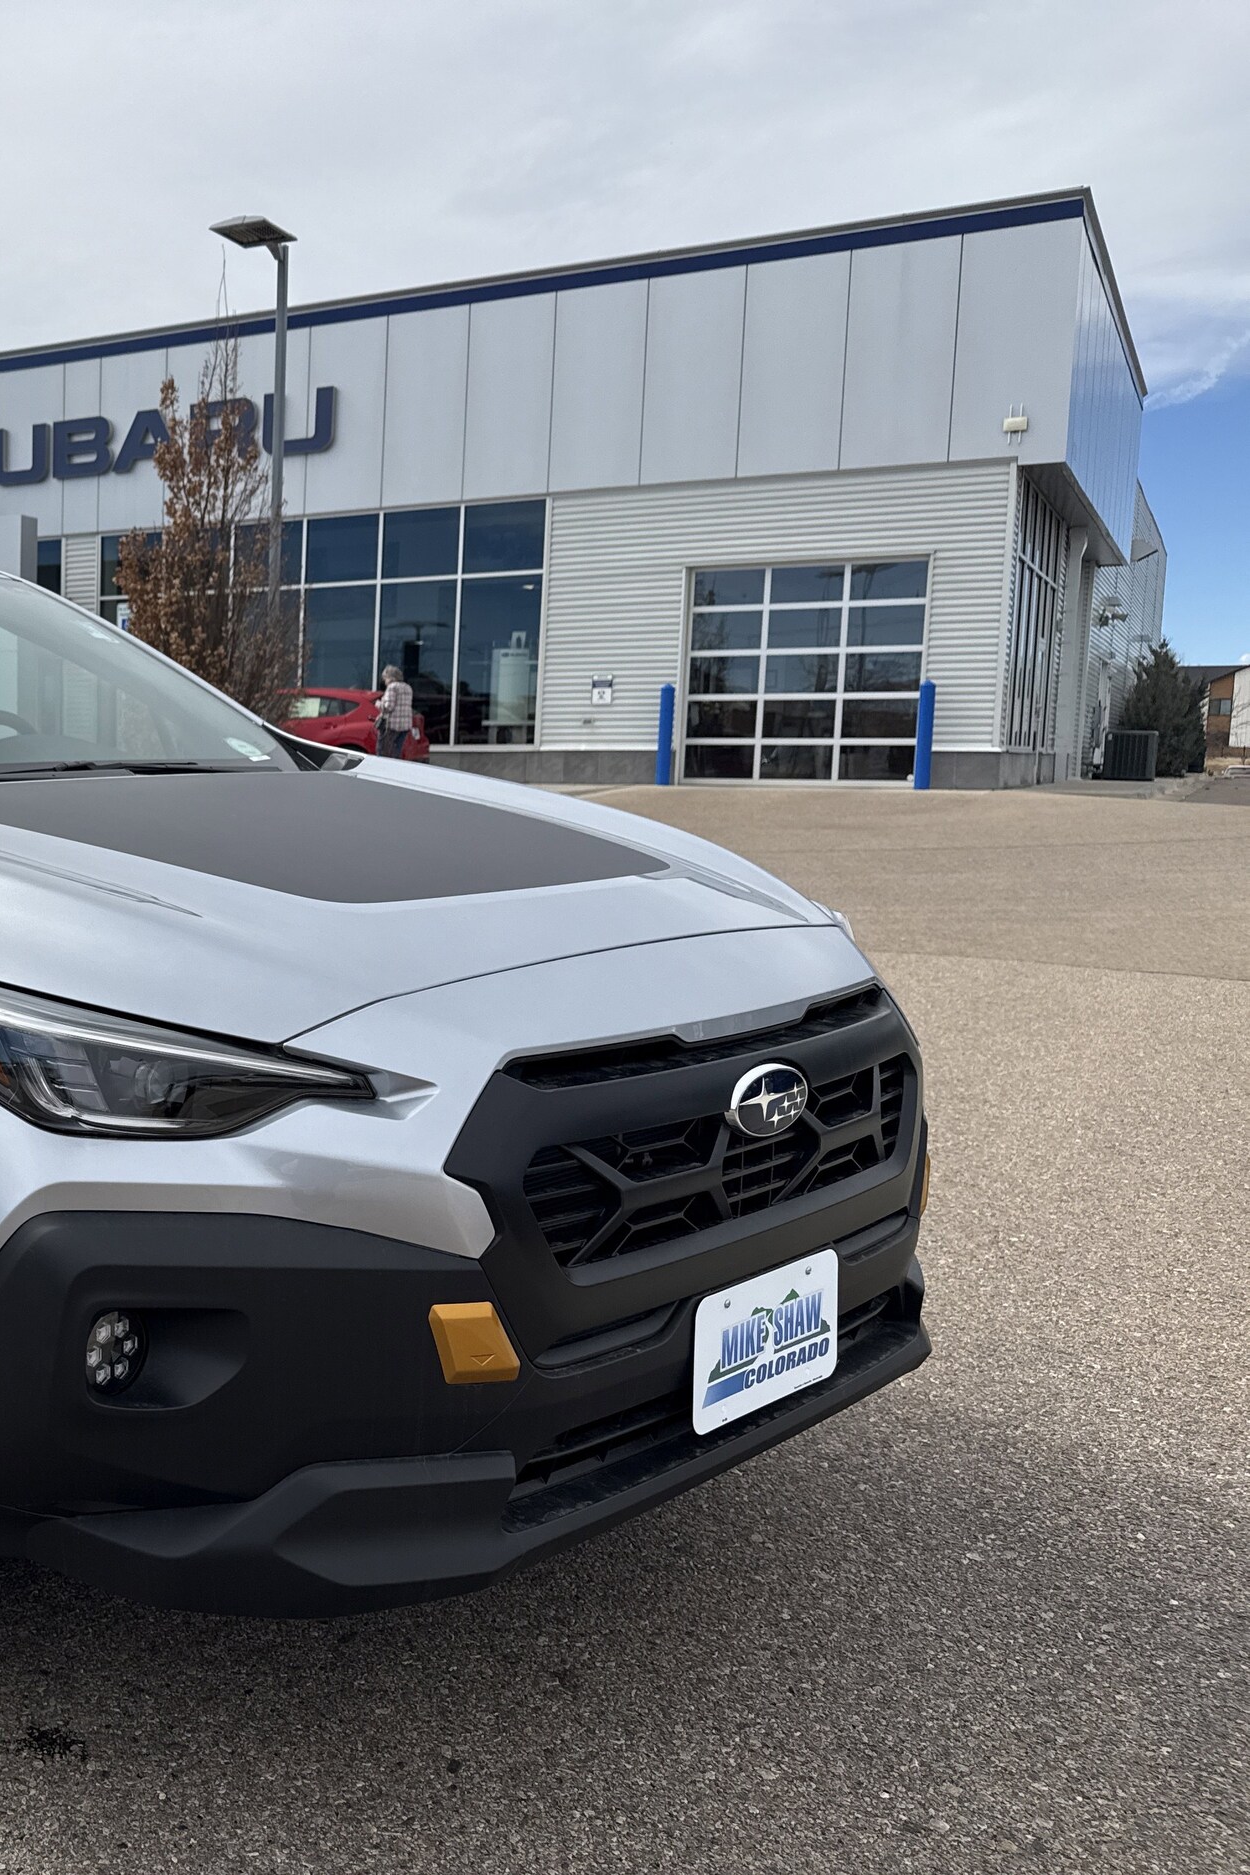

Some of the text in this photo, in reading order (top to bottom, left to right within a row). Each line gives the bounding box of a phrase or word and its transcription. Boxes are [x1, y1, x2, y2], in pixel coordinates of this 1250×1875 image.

[721, 1291, 823, 1369] MIKE SHAW
[744, 1337, 830, 1390] COLORADO
